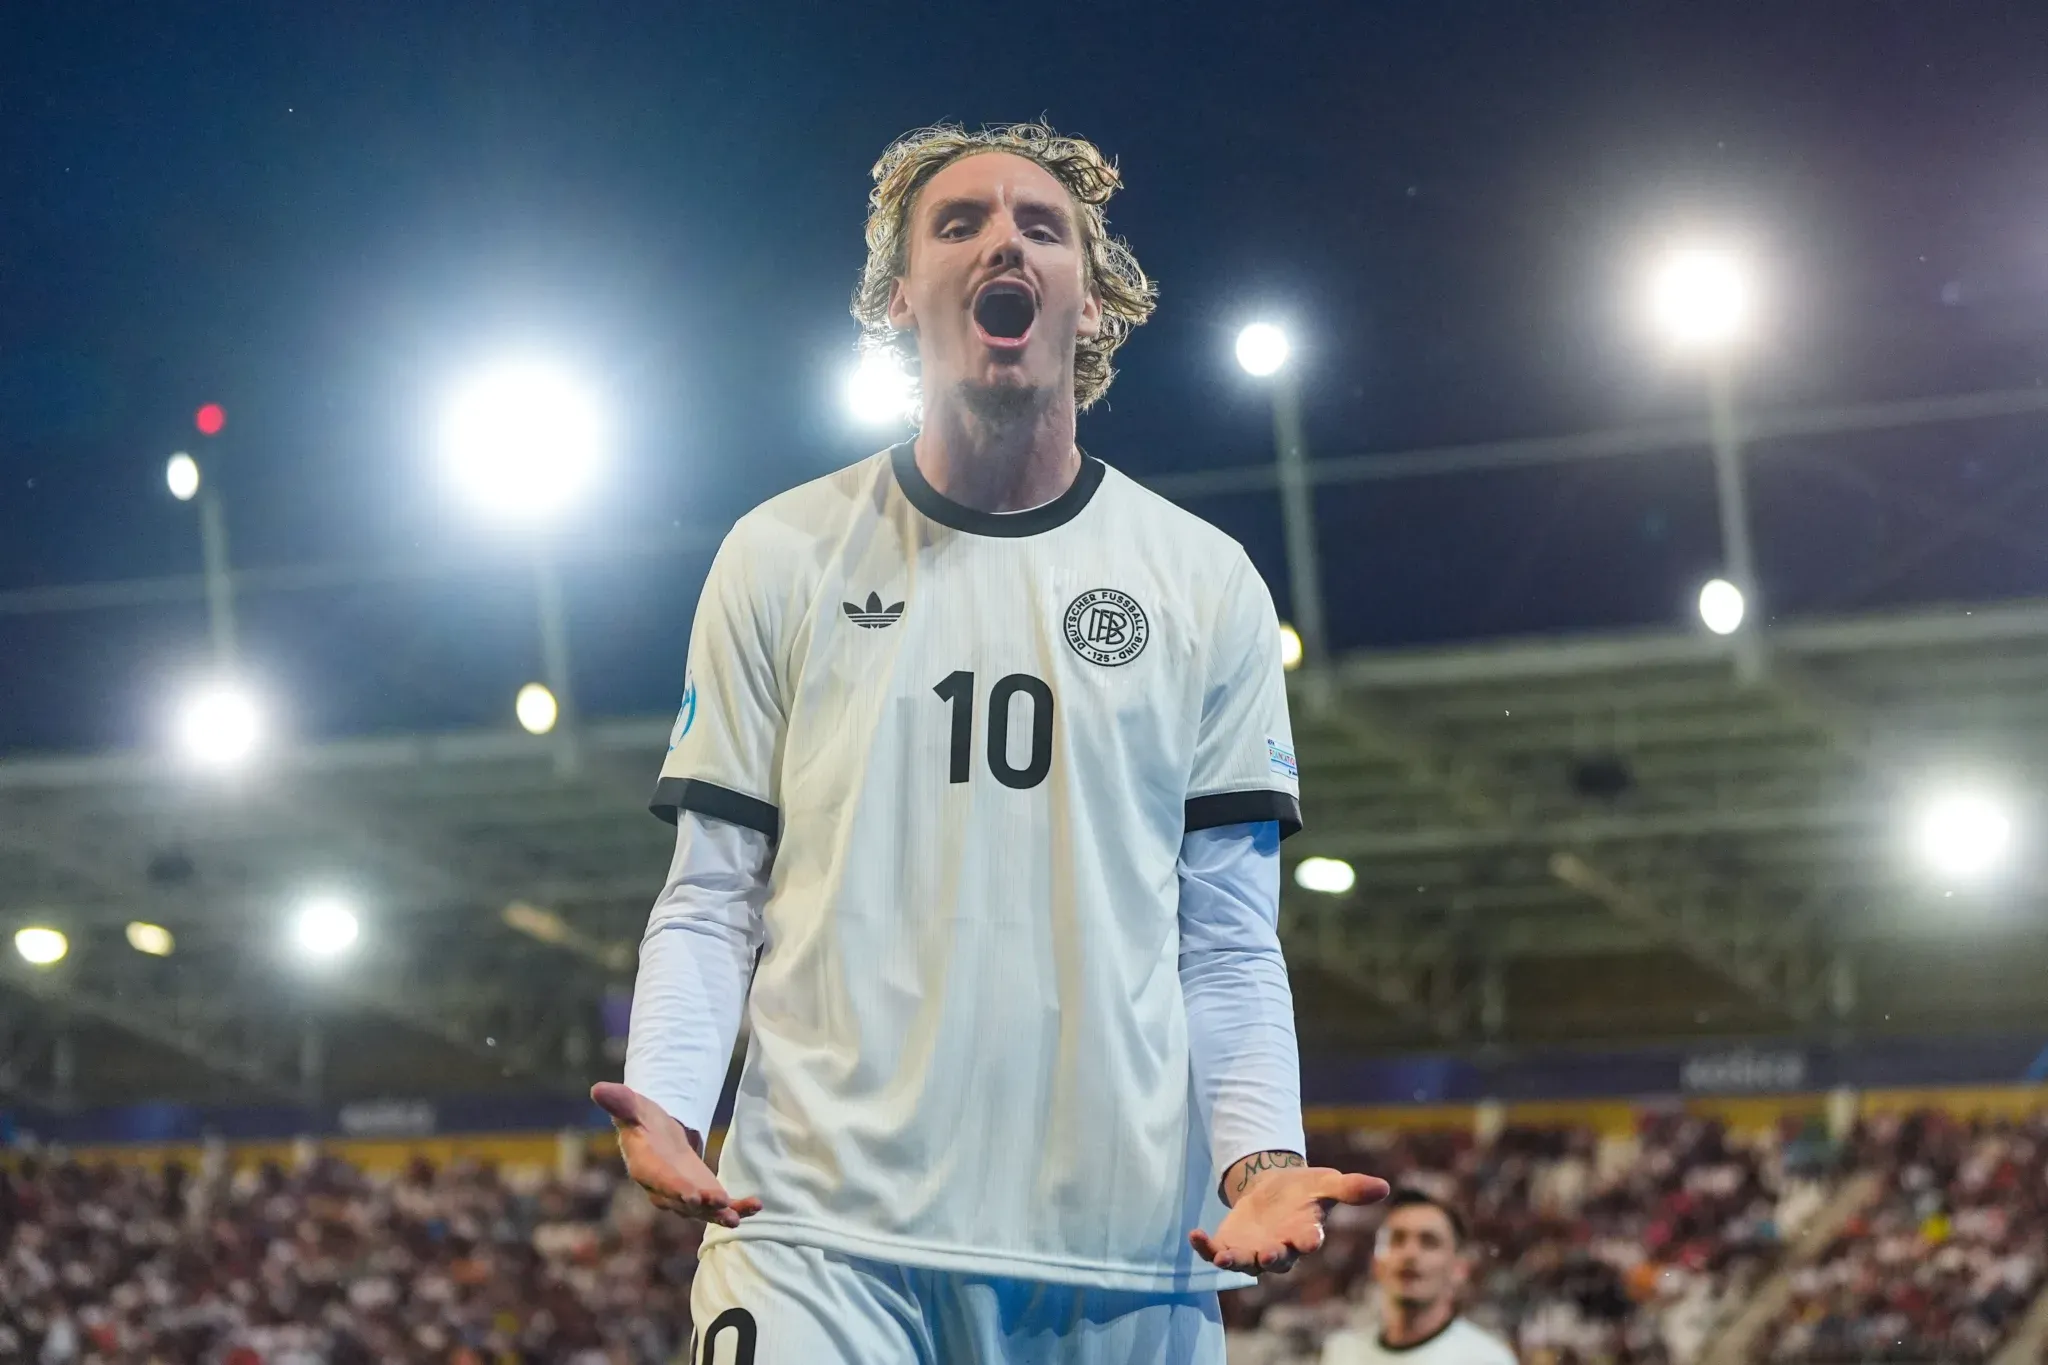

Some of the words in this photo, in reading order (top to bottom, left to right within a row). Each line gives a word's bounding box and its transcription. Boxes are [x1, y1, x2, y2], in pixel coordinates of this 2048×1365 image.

[1068, 593, 1097, 650] DEUTSCHER
[1101, 591, 1144, 660] FUSSBALL-BUND
[932, 670, 1054, 790] 10
[691, 1307, 757, 1365] 0
